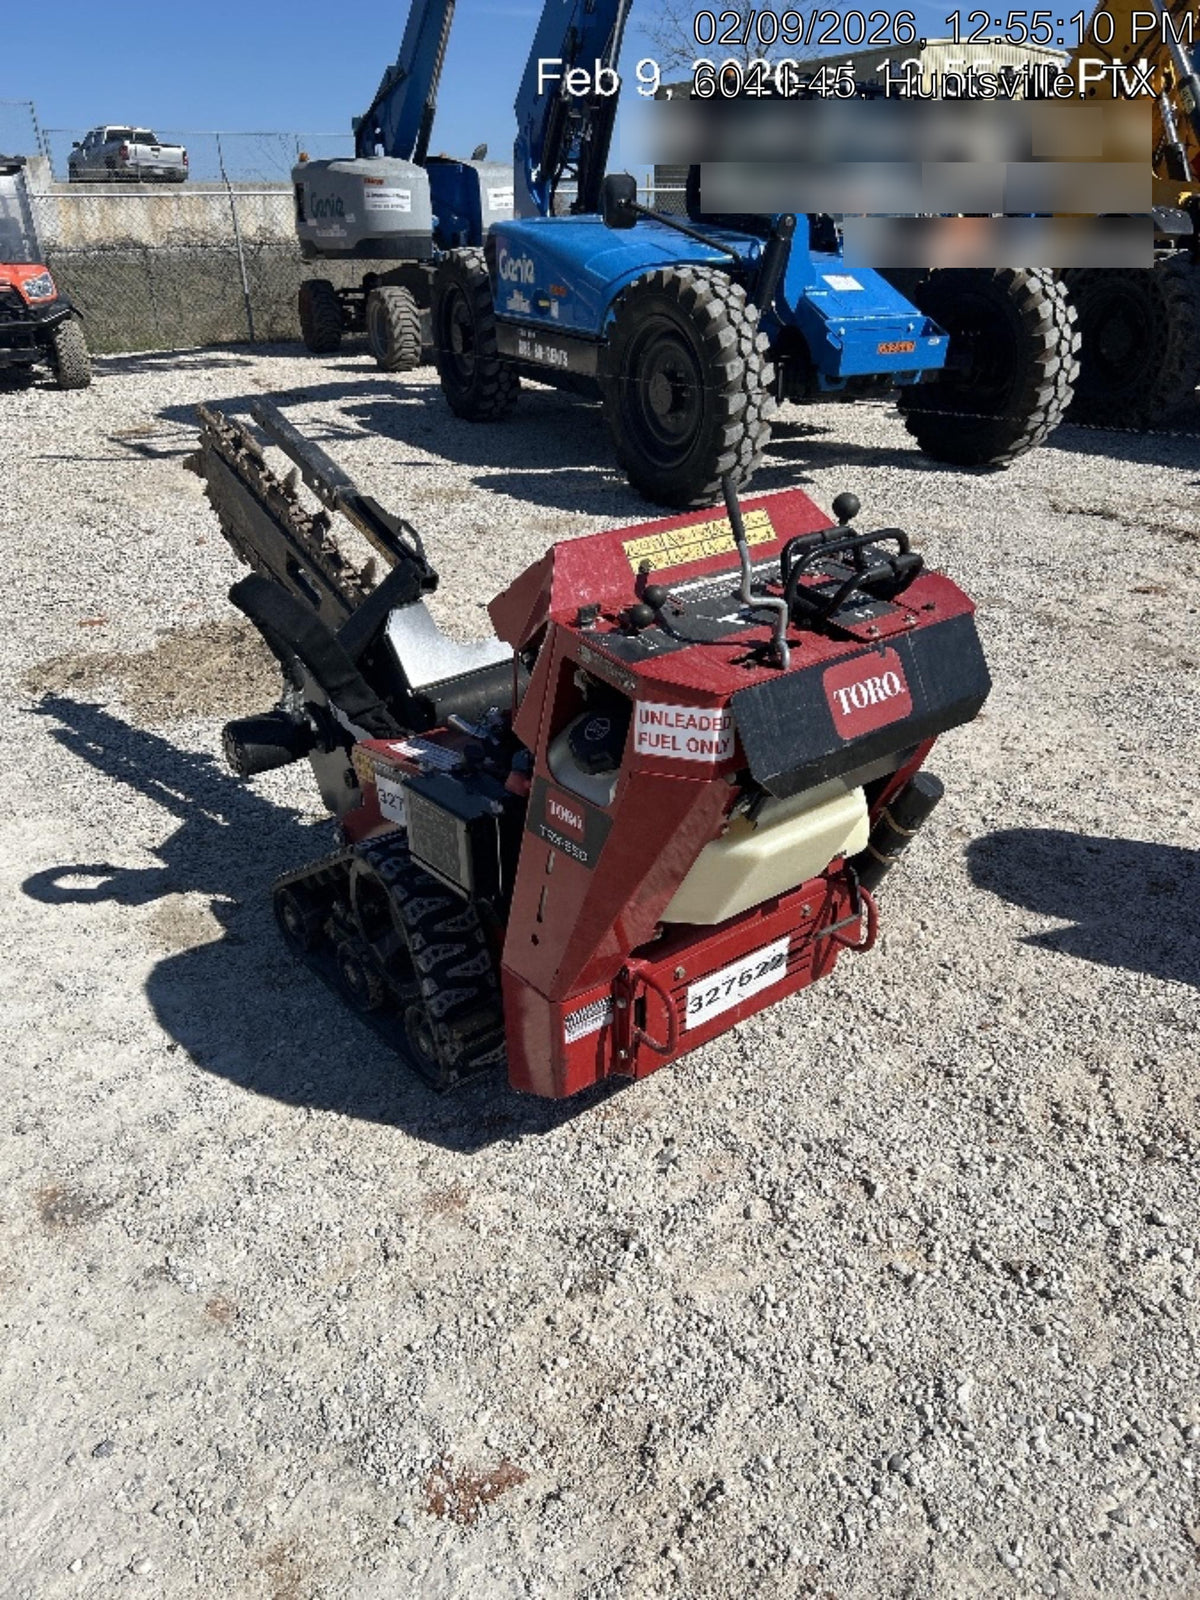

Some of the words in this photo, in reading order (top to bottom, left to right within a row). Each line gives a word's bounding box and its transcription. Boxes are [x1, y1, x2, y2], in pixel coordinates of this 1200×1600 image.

[499, 248, 536, 284] Genie
[832, 671, 905, 716] TORO
[638, 708, 732, 732] UNLEADED
[637, 731, 683, 753] FUEL
[686, 736, 731, 756] ONLY
[688, 952, 786, 1014] 327622
